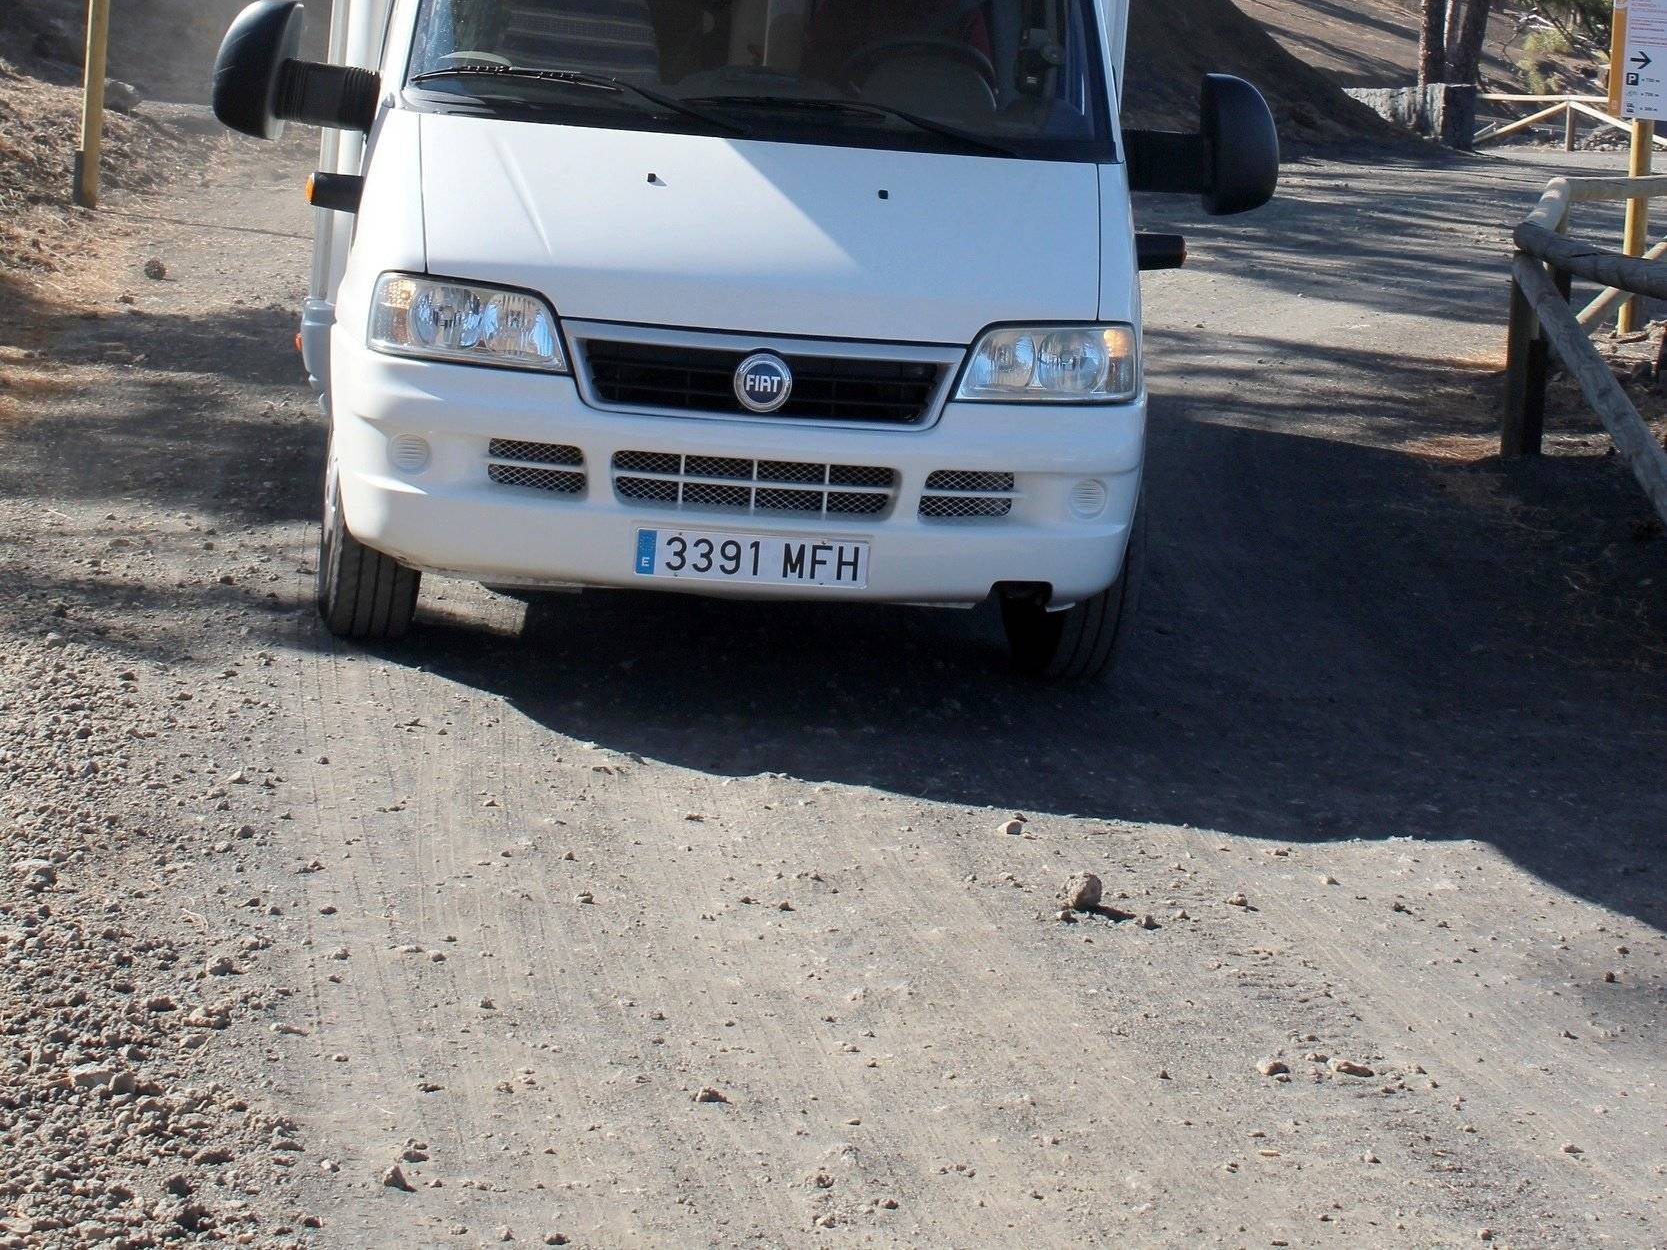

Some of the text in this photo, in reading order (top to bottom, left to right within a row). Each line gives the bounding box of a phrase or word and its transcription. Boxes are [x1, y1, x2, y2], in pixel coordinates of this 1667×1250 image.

[745, 374, 781, 393] FIAT
[641, 536, 860, 581] E 3391 MFH
